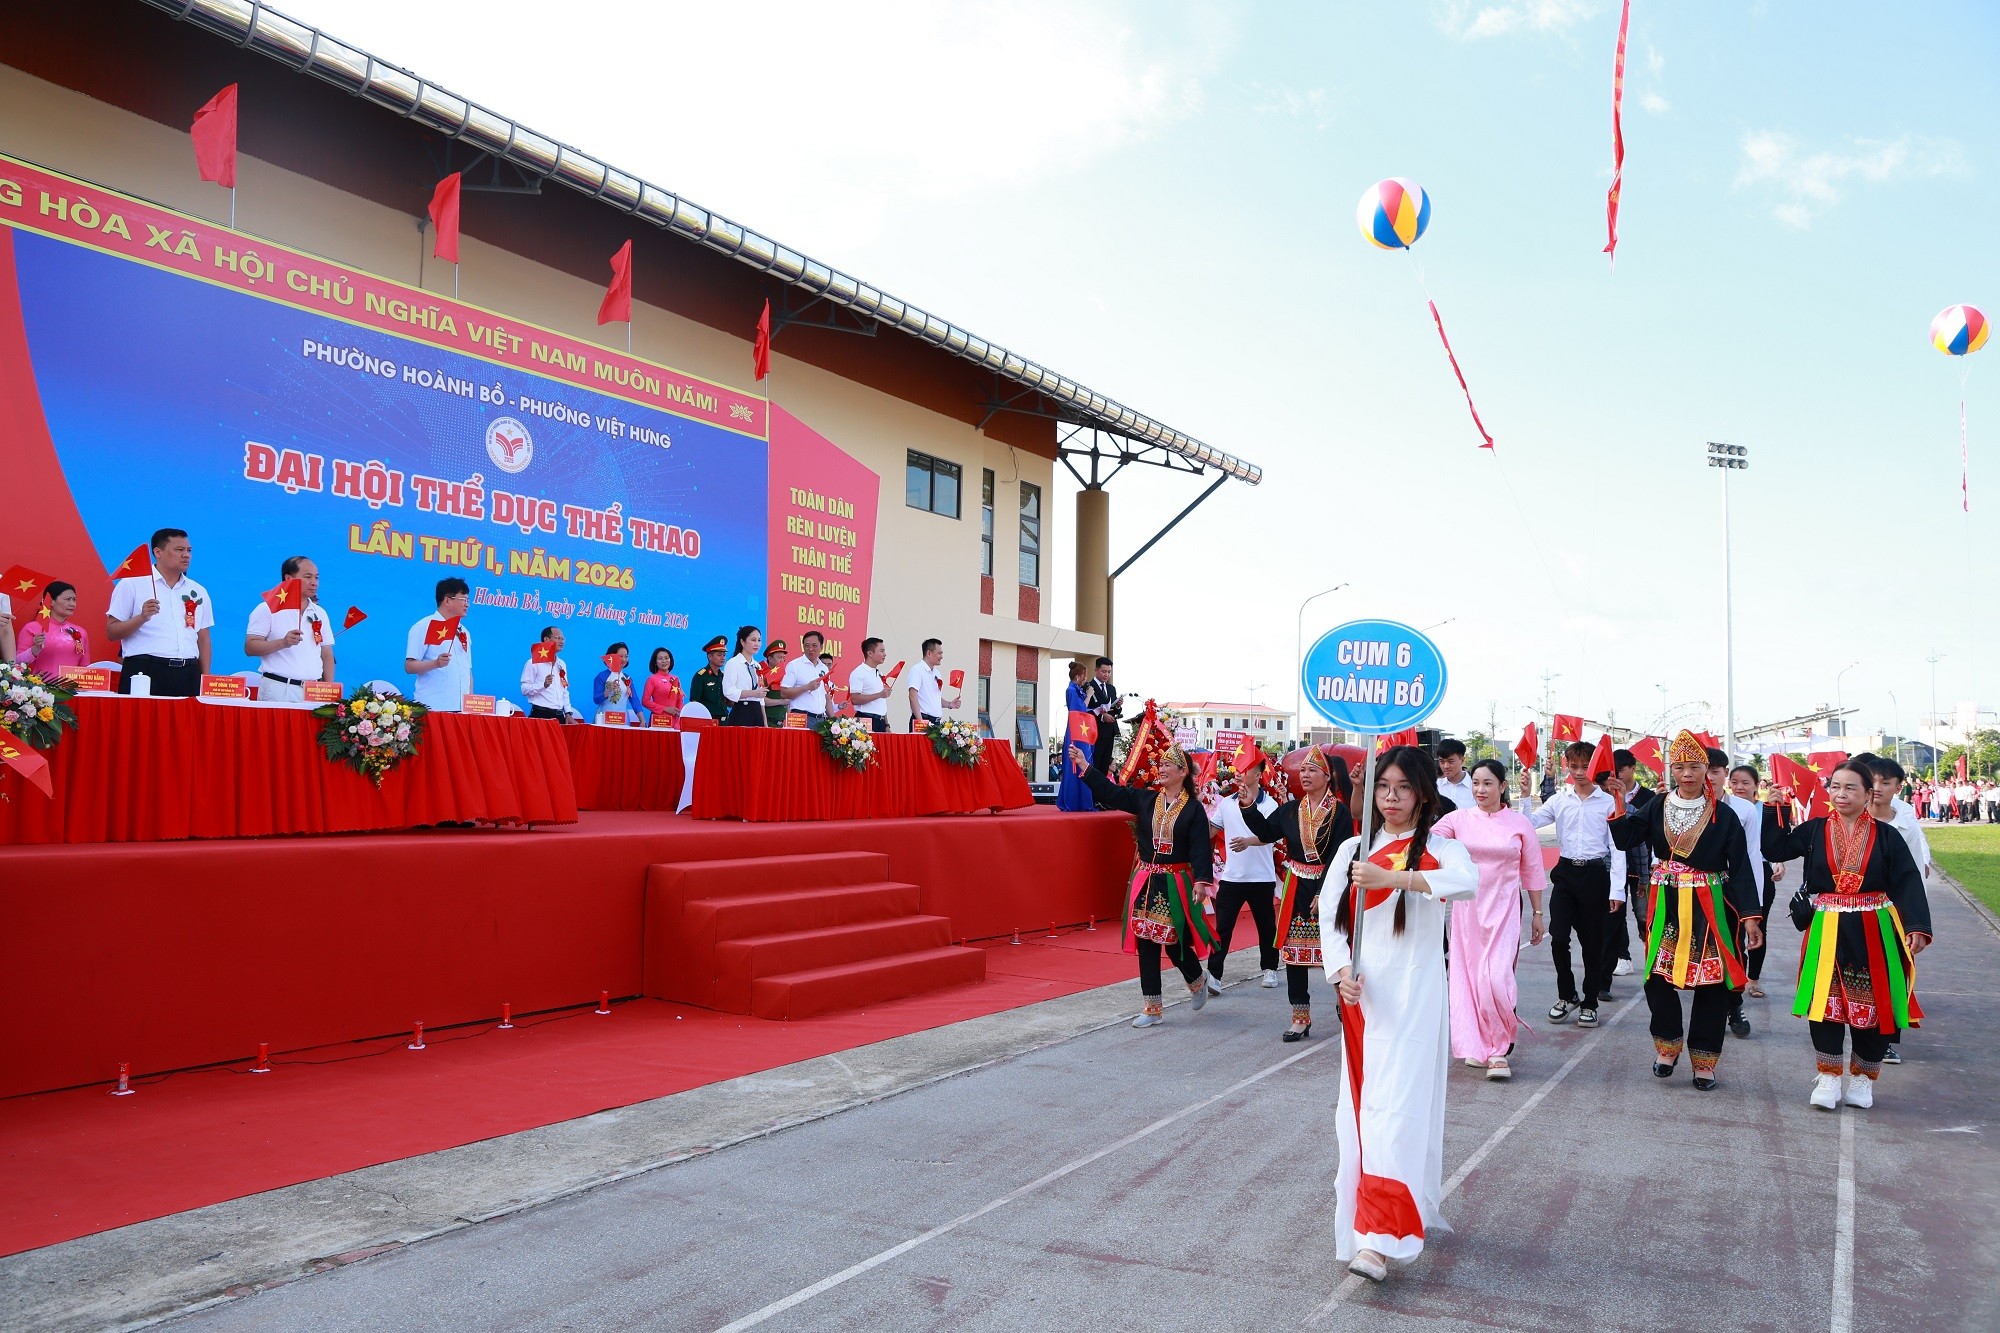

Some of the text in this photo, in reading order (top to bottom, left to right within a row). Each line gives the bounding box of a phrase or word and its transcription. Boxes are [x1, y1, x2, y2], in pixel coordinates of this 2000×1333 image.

[40, 191, 131, 241] HÒA
[145, 224, 201, 261] XÃ
[214, 246, 275, 284] HỘI
[286, 269, 354, 305] CHỦ
[365, 291, 458, 336] NGHĨA
[466, 321, 523, 355] VIỆT
[531, 341, 586, 374] NAM
[594, 360, 661, 396] MUÔN
[667, 382, 718, 413] NĂM!
[303, 339, 397, 378] PHƯỜNG
[403, 365, 474, 399] HOÀNH
[479, 381, 505, 406] BỒ
[520, 396, 591, 428] PHƯỜNG
[595, 416, 626, 439] VIỆT
[629, 425, 672, 449] HƯNG
[245, 442, 700, 559] ĐẠI HỘI THỂ DỤC THỂ THAO
[790, 487, 854, 520] TOÀN DÂN
[787, 515, 856, 549] RÈN LUYỆN
[349, 520, 635, 591] LẦN THỨ I, NĂM 2026
[791, 545, 852, 575] THÂN THỂ
[781, 573, 861, 604] THEO GƯƠNG
[473, 587, 518, 608] Hoành
[545, 598, 575, 619] ngày
[577, 600, 591, 617] 24
[594, 603, 626, 626] tháng
[629, 607, 636, 623] 5
[638, 610, 662, 626] năm
[664, 612, 689, 630] 2026
[798, 604, 845, 630] BÁC HỒ
[1337, 640, 1411, 671] CỤM 6
[1317, 673, 1425, 707] HOÀNH BỒ
